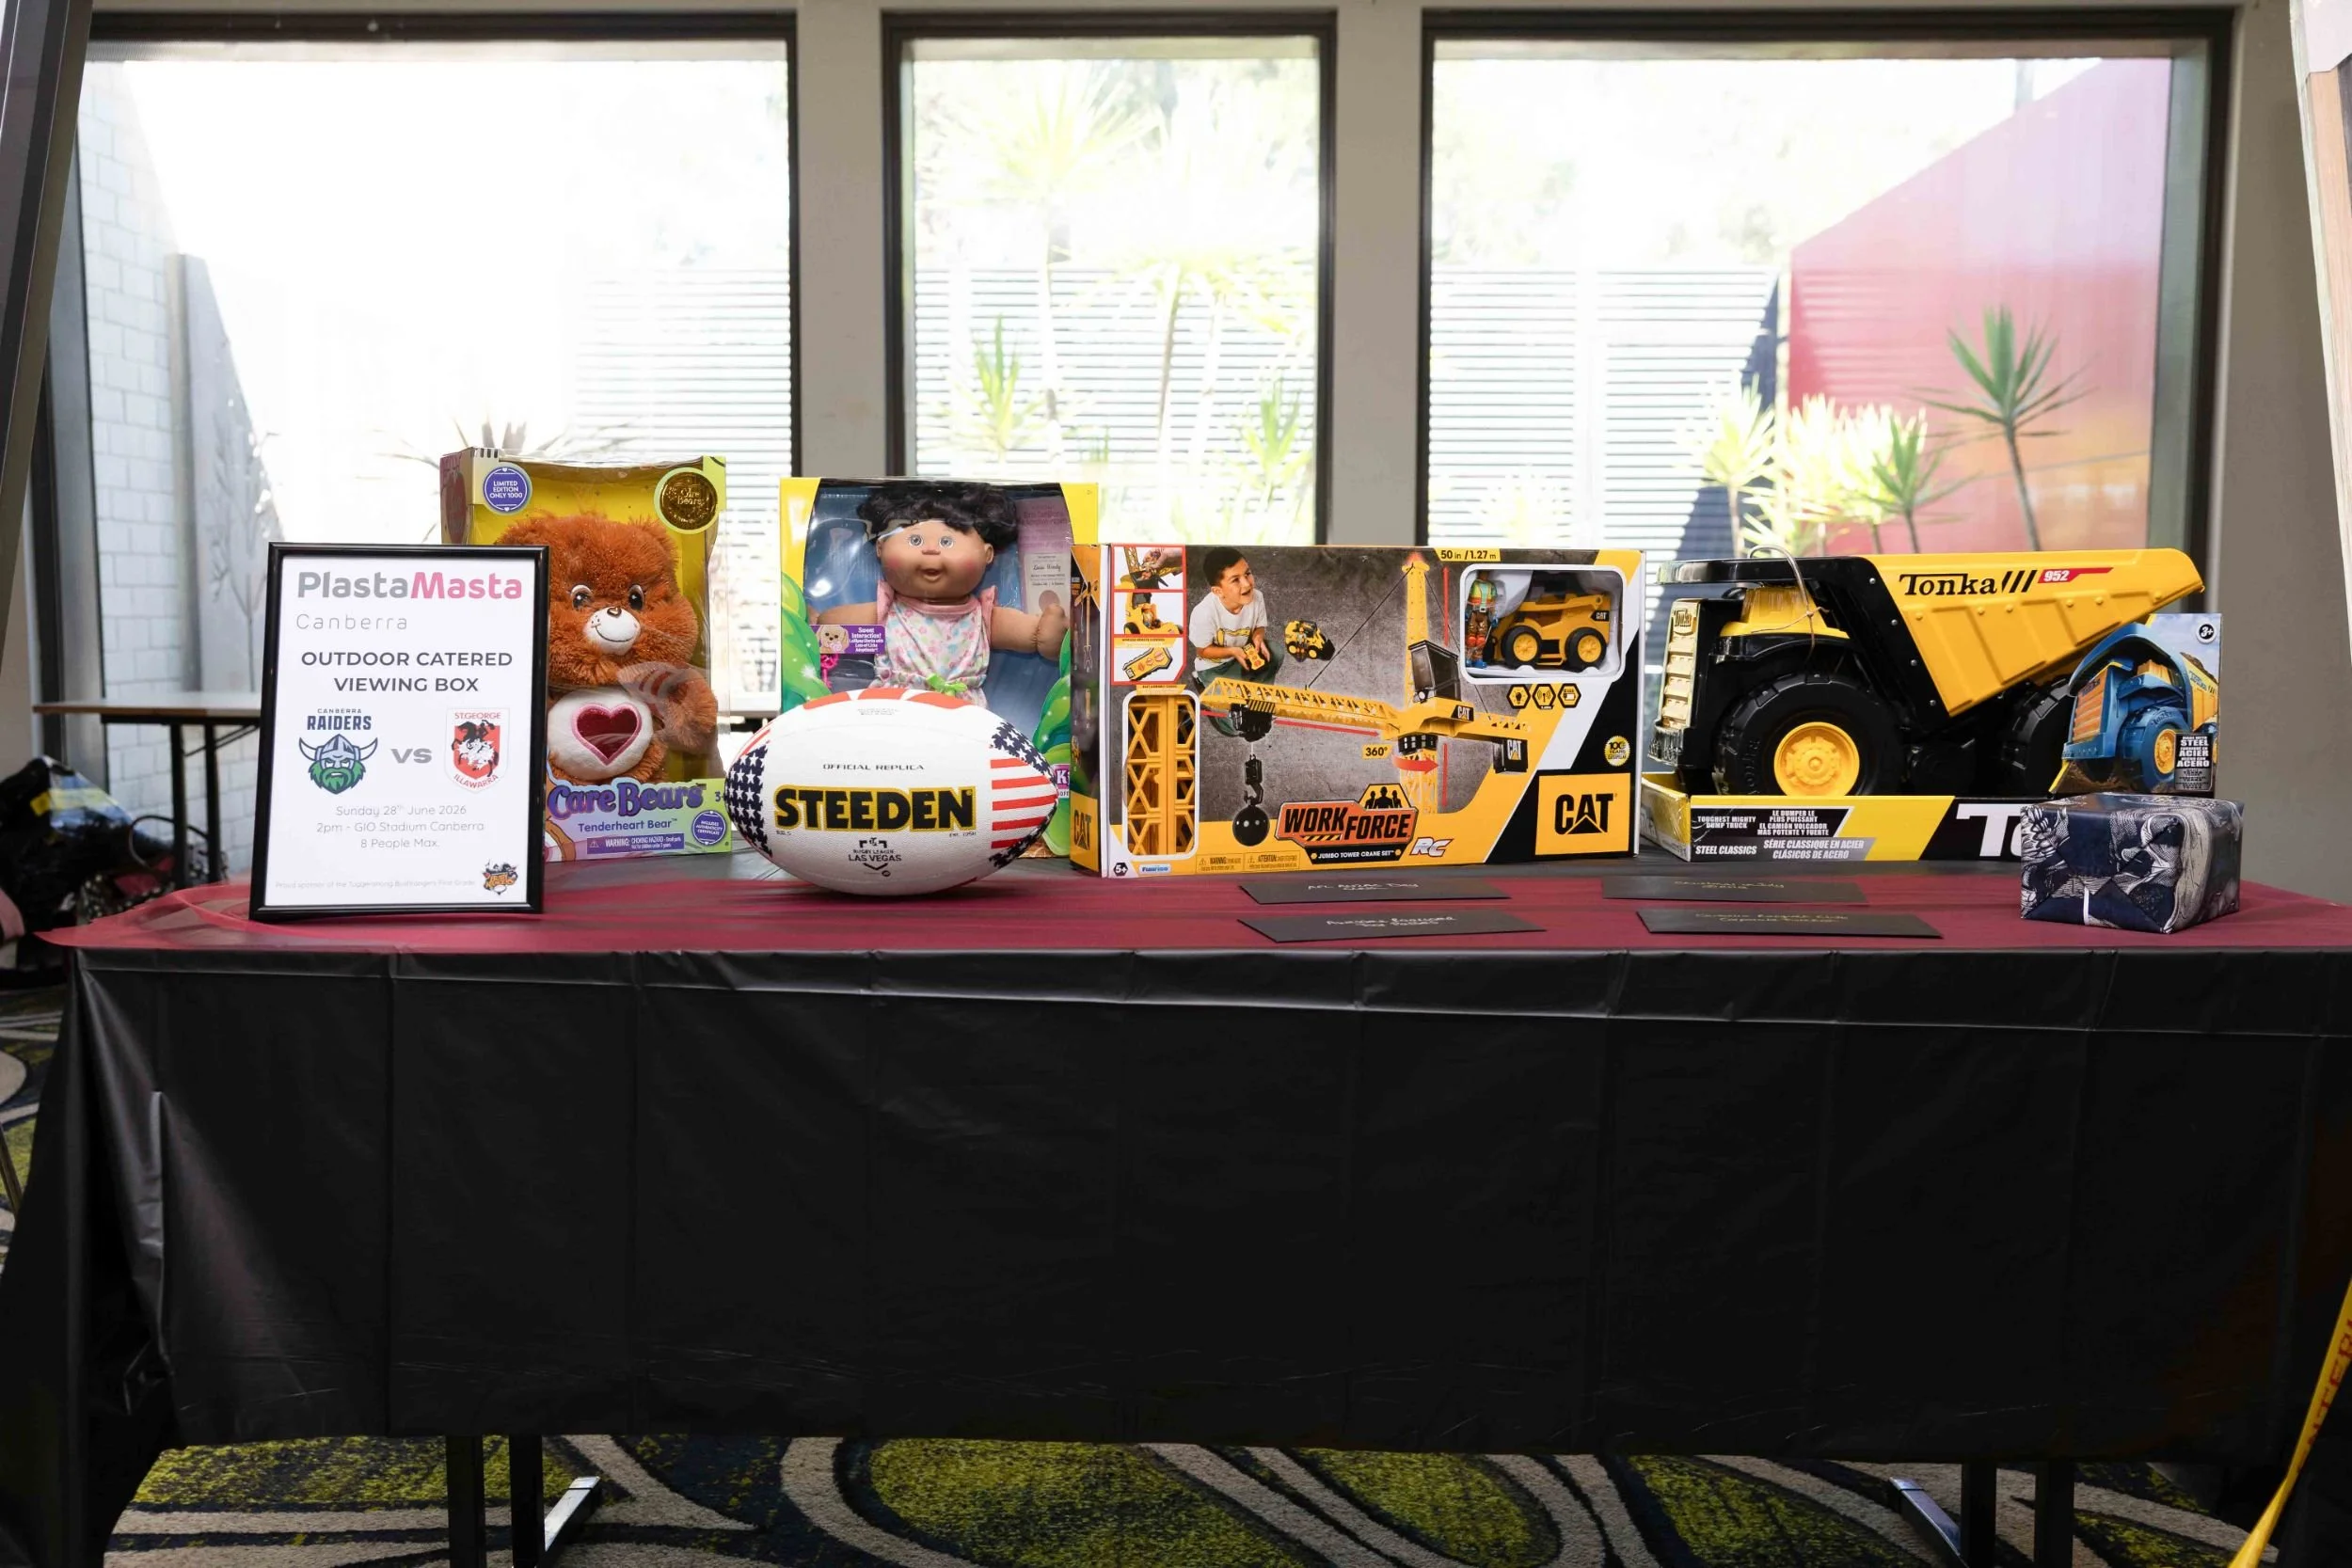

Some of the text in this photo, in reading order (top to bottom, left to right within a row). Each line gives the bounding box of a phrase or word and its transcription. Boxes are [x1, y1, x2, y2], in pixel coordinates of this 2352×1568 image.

[1440, 549, 1454, 560] 50
[1454, 551, 1462, 560] in
[297, 571, 522, 599] PlastaMasta
[1899, 570, 2070, 596] Tonka 952
[295, 613, 407, 630] Canberra
[1596, 611, 1608, 621] CAT
[2200, 626, 2214, 638] 3+
[301, 651, 513, 666] OUTDOOR CATERED
[334, 677, 479, 692] VIEWING BOX
[1457, 705, 1471, 721] CAT
[307, 715, 372, 731] RAIDERS
[1507, 738, 1522, 761] CAT
[453, 773, 499, 789] ILLAWARRA
[547, 783, 705, 819] Care Bears
[773, 785, 977, 832] STEEDEN
[336, 805, 380, 818] Sunday
[407, 805, 436, 816] June
[438, 805, 467, 816] 2026
[1555, 793, 1614, 835] CAT
[316, 822, 342, 834] 2pm
[354, 822, 376, 832] GIO
[379, 822, 427, 832] Stadium
[430, 821, 485, 832] Canberra
[578, 822, 644, 832] Tenderheart
[1073, 810, 1092, 851] CAT
[360, 839, 367, 848] 8
[371, 839, 411, 849] People
[1410, 837, 1454, 858] RC
[1694, 846, 1718, 855] STEEL
[1719, 846, 1757, 855] CLASSICS
[1763, 838, 1865, 850] SÉRIE CLASSIQUE EN ACIER
[868, 854, 902, 863] VEGAS
[1812, 850, 1823, 860] DE
[1823, 850, 1849, 860] ACERO
[1115, 863, 1128, 874] 5+
